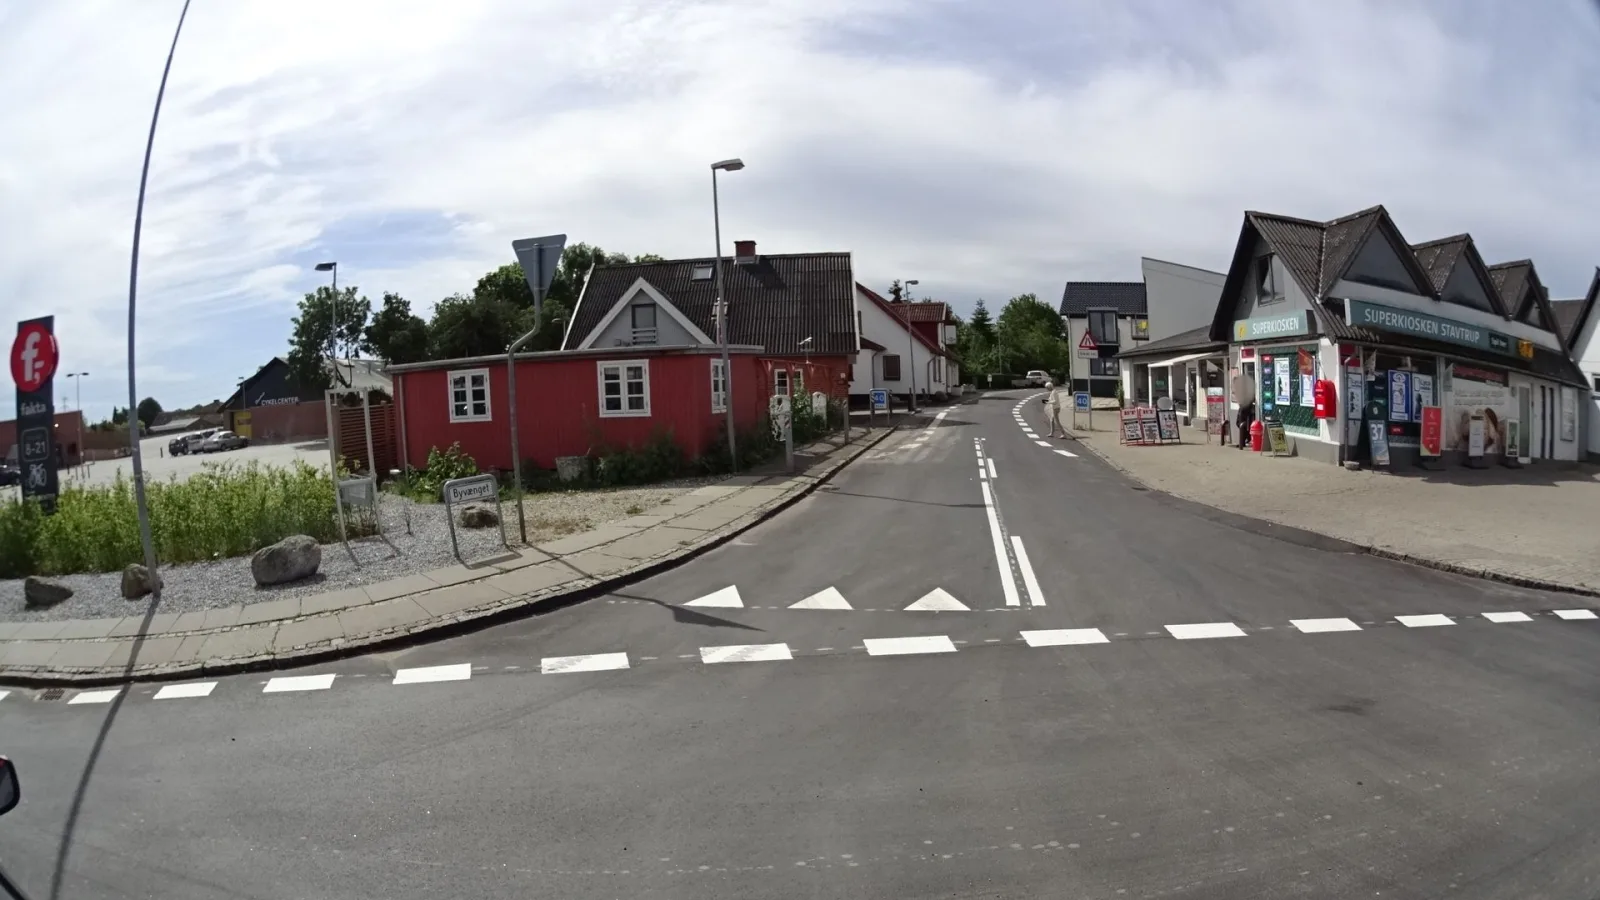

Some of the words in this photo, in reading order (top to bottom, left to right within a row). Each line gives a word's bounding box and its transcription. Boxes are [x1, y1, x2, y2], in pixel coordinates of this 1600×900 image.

[1252, 317, 1299, 335] SUPERKIOSKEN
[1364, 308, 1439, 336] SUPERKIOSKEN
[1440, 323, 1480, 344] STAVTRUP
[20, 402, 47, 416] fakta
[261, 396, 299, 406] CYKELCENTER
[1077, 397, 1087, 405] 40
[1370, 423, 1384, 441] 37
[453, 484, 490, 500] Byvænget
